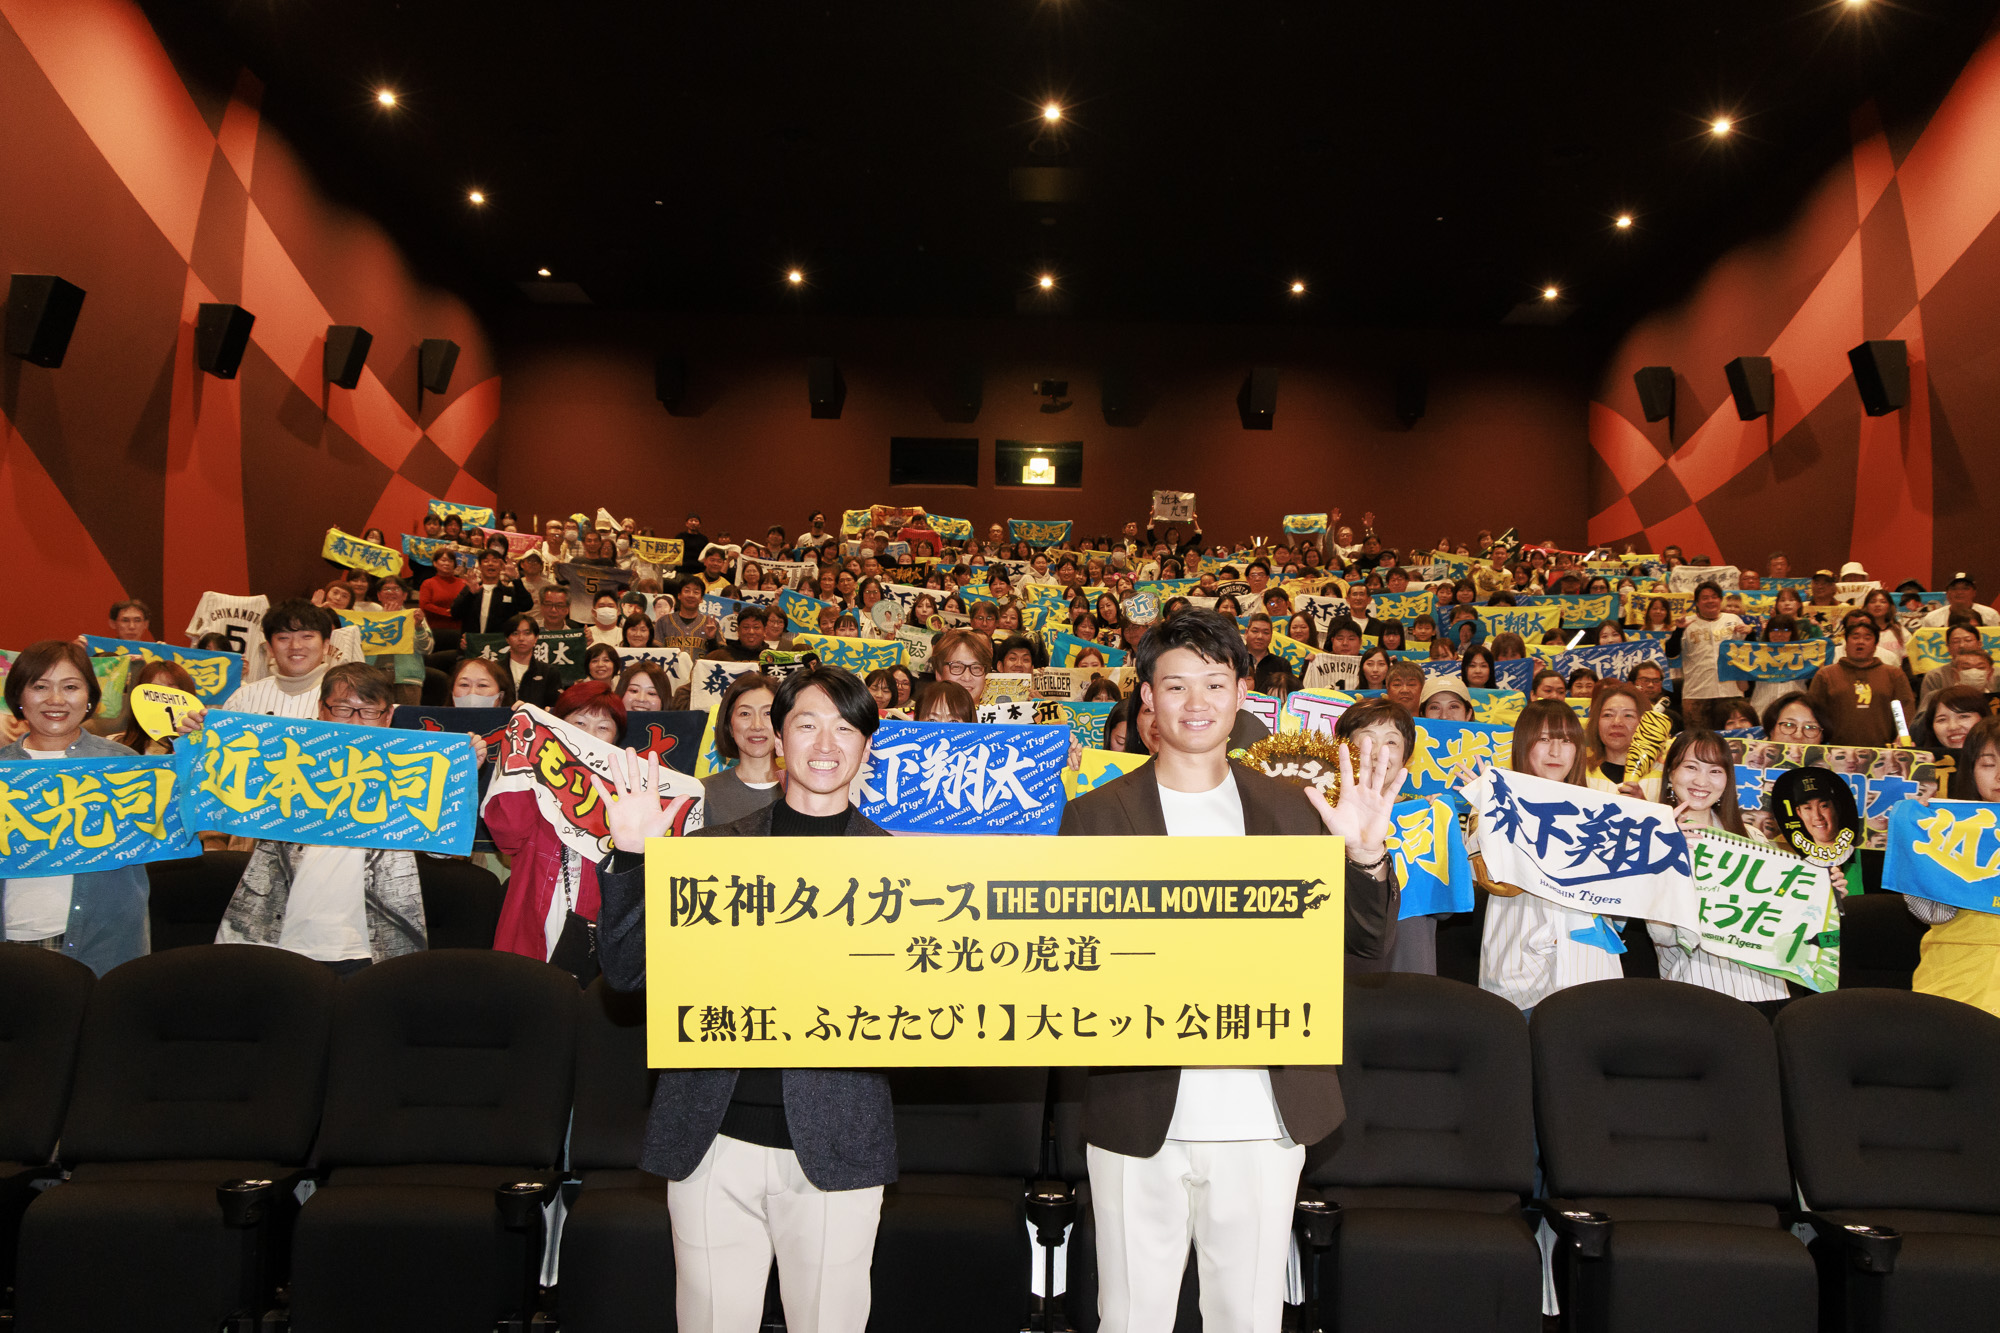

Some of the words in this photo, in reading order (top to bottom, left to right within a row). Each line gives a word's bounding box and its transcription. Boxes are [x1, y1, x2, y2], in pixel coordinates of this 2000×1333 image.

[585, 577, 600, 595] 5
[226, 624, 249, 655] 5
[1726, 639, 1828, 672] 近本光司
[143, 688, 189, 707] MORISHITA
[1026, 729, 1060, 750] Tigers
[199, 729, 451, 833] 近本光司
[1783, 799, 1794, 817] 1
[382, 823, 420, 841] Tigers
[1792, 828, 1854, 861] もりしたしょうた
[1694, 843, 1817, 901] もりした
[669, 873, 981, 928] 阪神タイガース
[993, 886, 1039, 914] THE
[1044, 886, 1156, 914] OFFICIAL
[1160, 886, 1239, 913] MOVIE
[1243, 885, 1299, 913] 2025
[1579, 889, 1622, 906] Tigers
[1728, 934, 1763, 950] Tigers
[1786, 922, 1809, 963] 1
